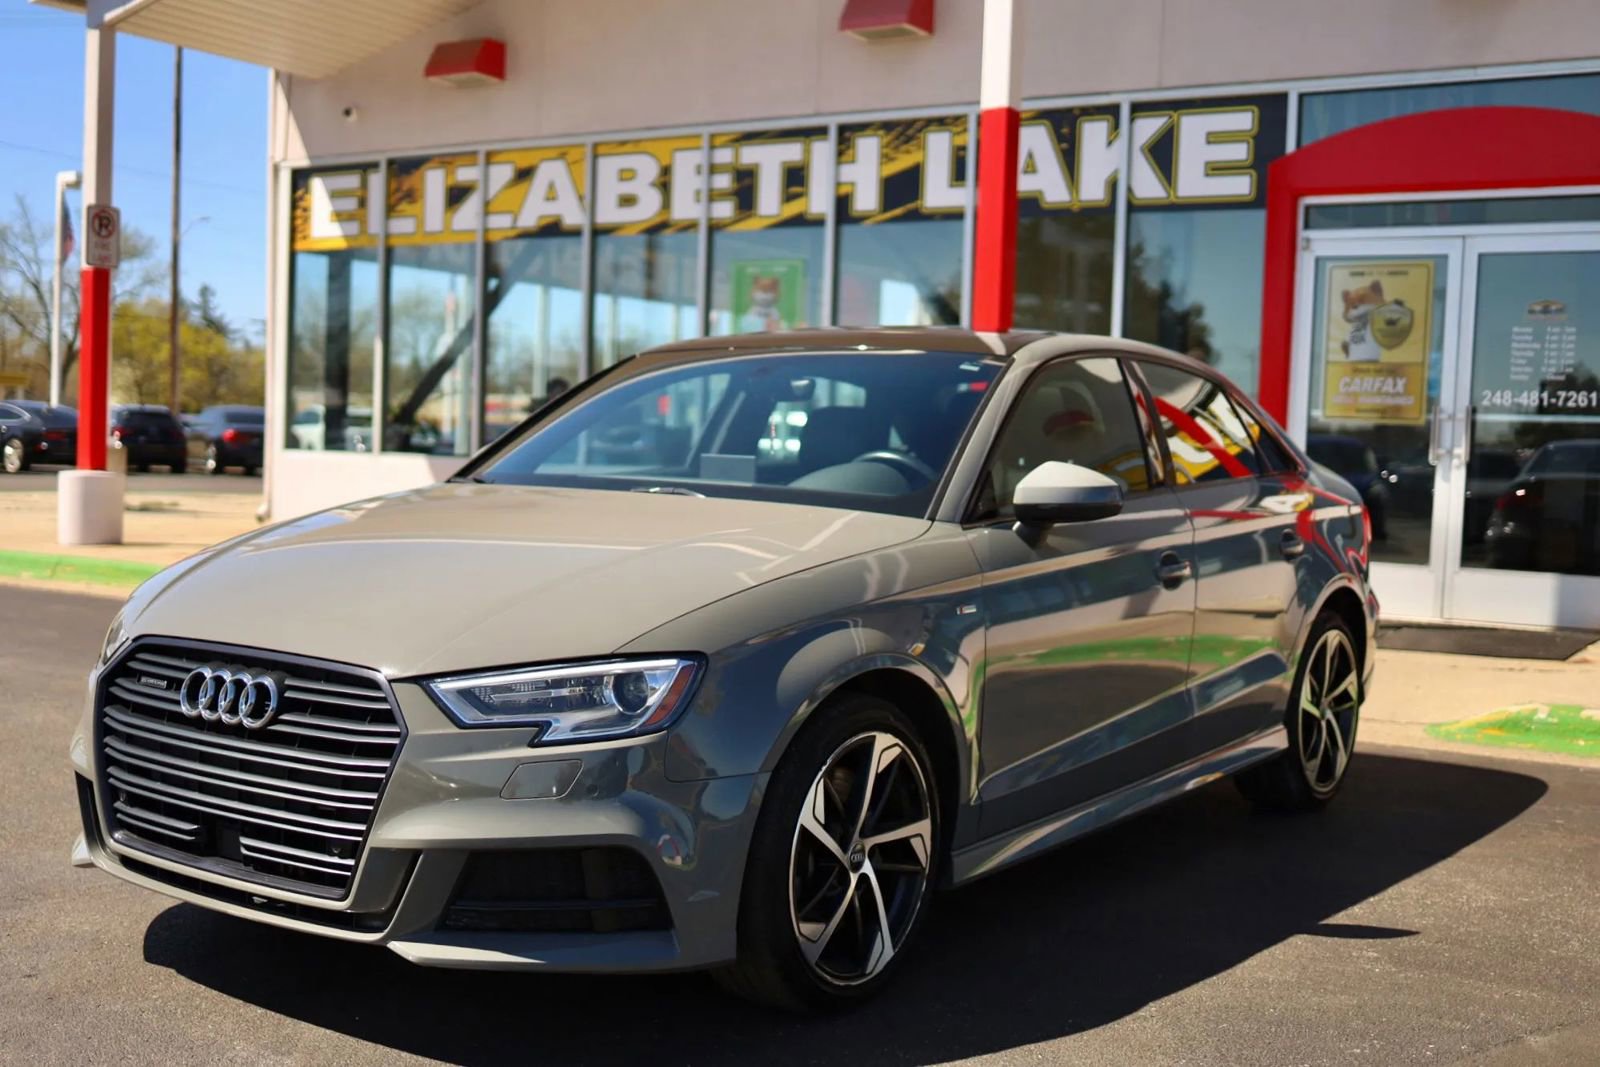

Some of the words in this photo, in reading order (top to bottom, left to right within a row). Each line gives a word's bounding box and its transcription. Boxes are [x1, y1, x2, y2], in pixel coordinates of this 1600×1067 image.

[309, 132, 882, 239] ELIZABETH
[922, 106, 1258, 211] LAKE
[1339, 376, 1407, 393] CARFAX
[1481, 390, 1598, 407] 248-481-7261
